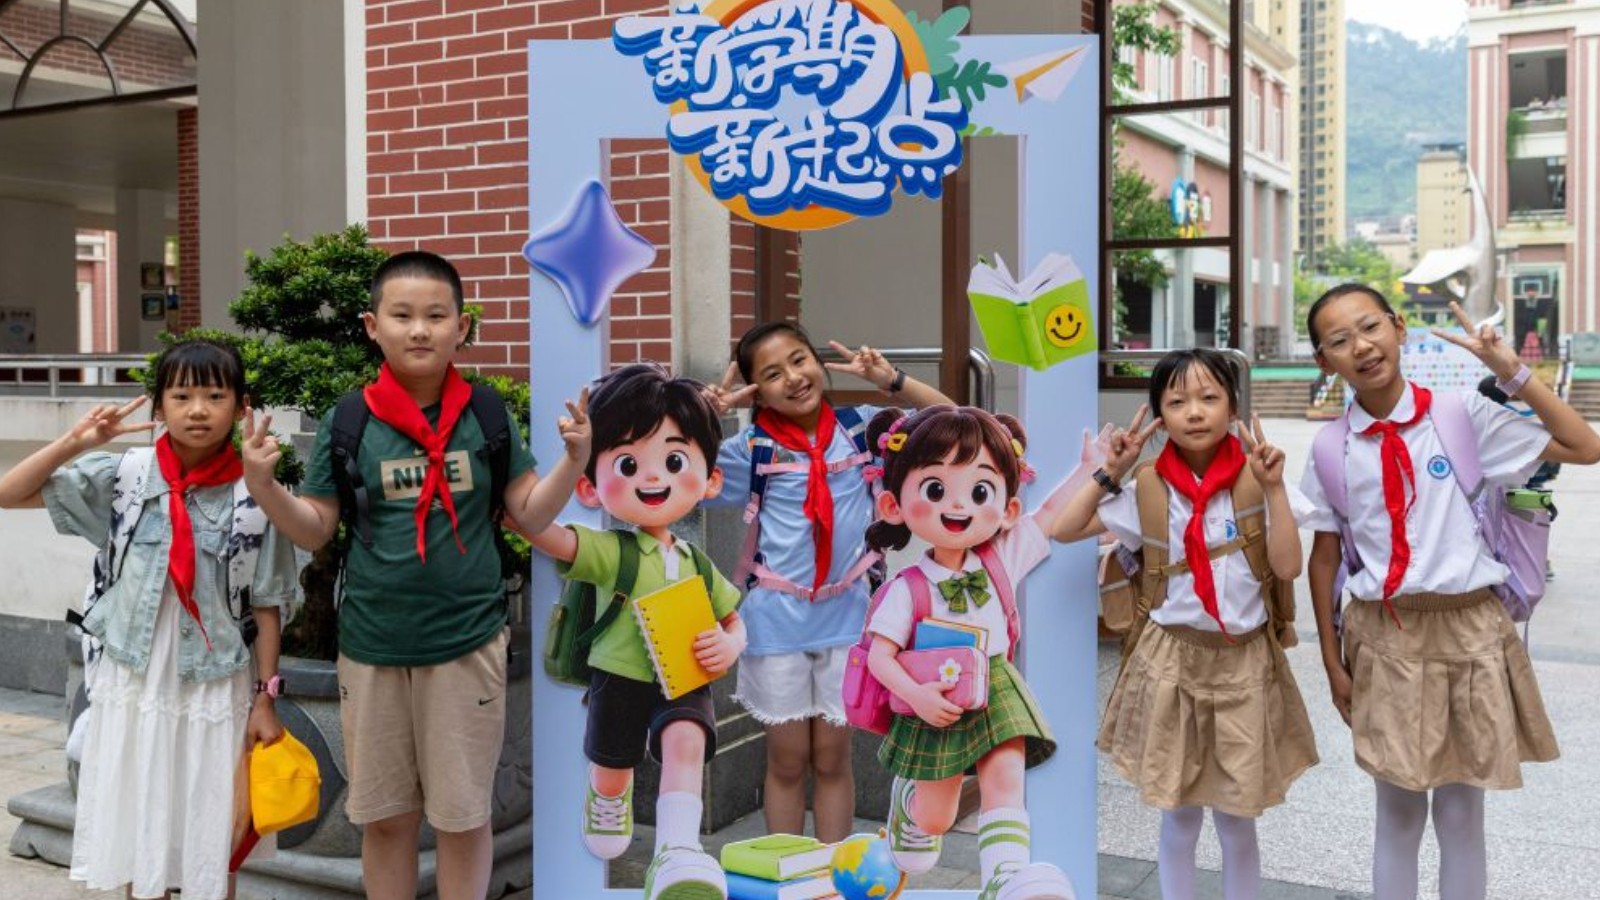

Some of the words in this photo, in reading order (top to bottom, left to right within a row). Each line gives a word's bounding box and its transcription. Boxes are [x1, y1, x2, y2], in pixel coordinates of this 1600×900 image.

[613, 0, 900, 120] 新学期
[669, 71, 963, 200] 新起点
[393, 459, 462, 490] NIE
